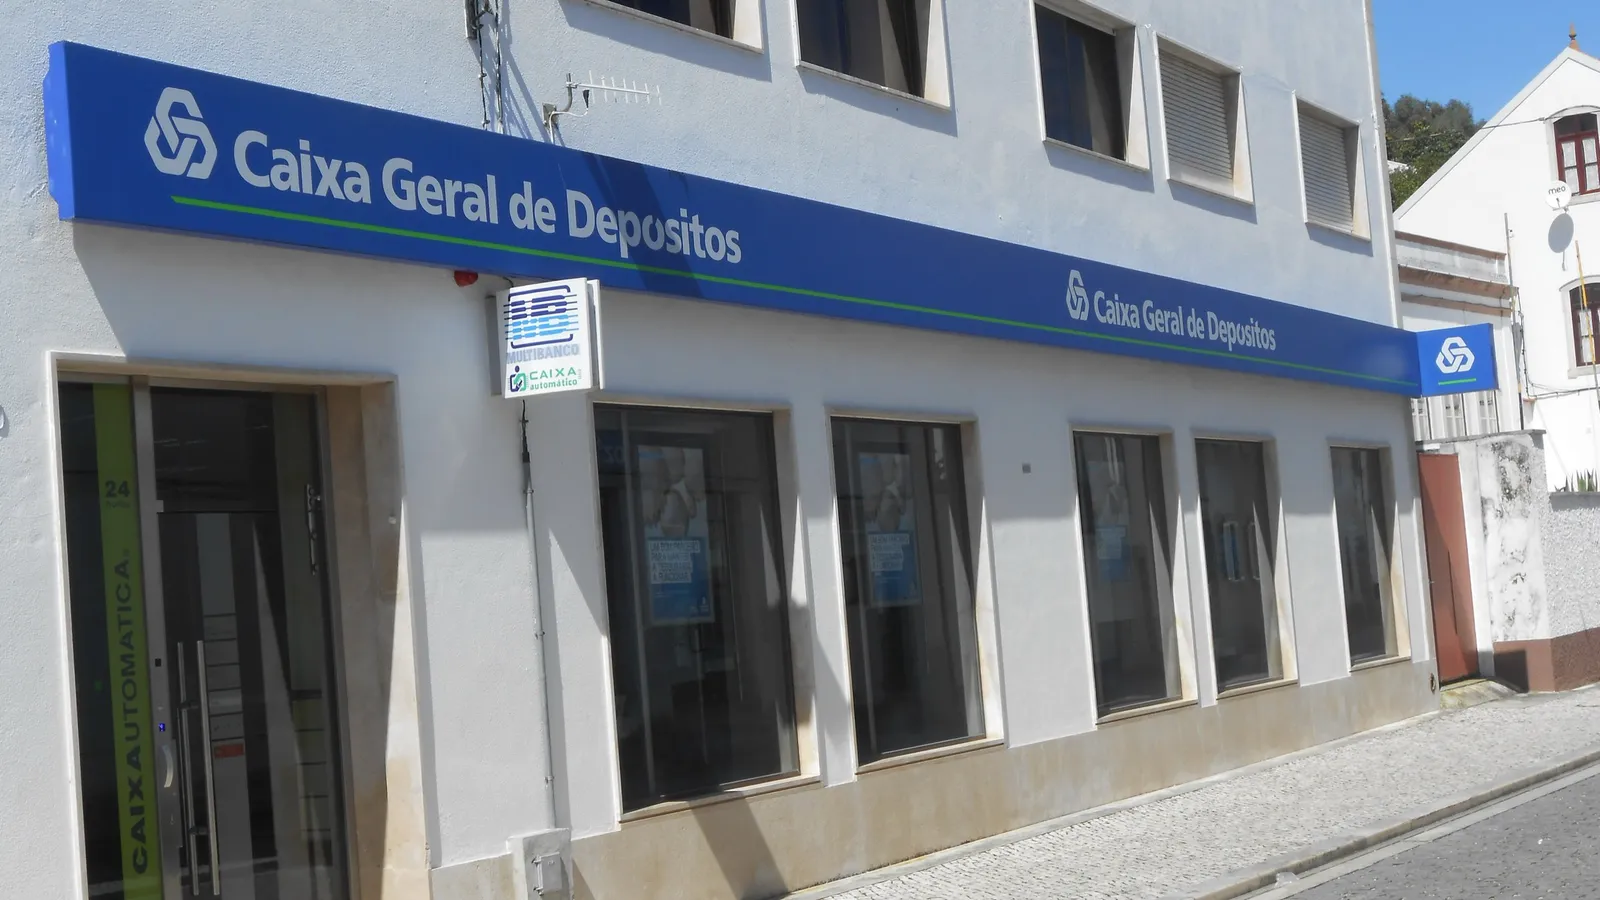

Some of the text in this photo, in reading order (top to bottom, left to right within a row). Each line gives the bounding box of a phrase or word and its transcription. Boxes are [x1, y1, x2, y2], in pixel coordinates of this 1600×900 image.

[234, 130, 371, 204] Caixa
[382, 157, 499, 224] Geral
[509, 181, 556, 234] de
[1548, 185, 1566, 195] meo
[1094, 291, 1140, 328] Caixa
[1143, 300, 1184, 336] Geral
[1187, 308, 1205, 339] de
[506, 344, 579, 364] MULTIBANCO
[529, 367, 577, 380] CAIXA
[529, 378, 578, 389] automático
[105, 480, 130, 498] 24
